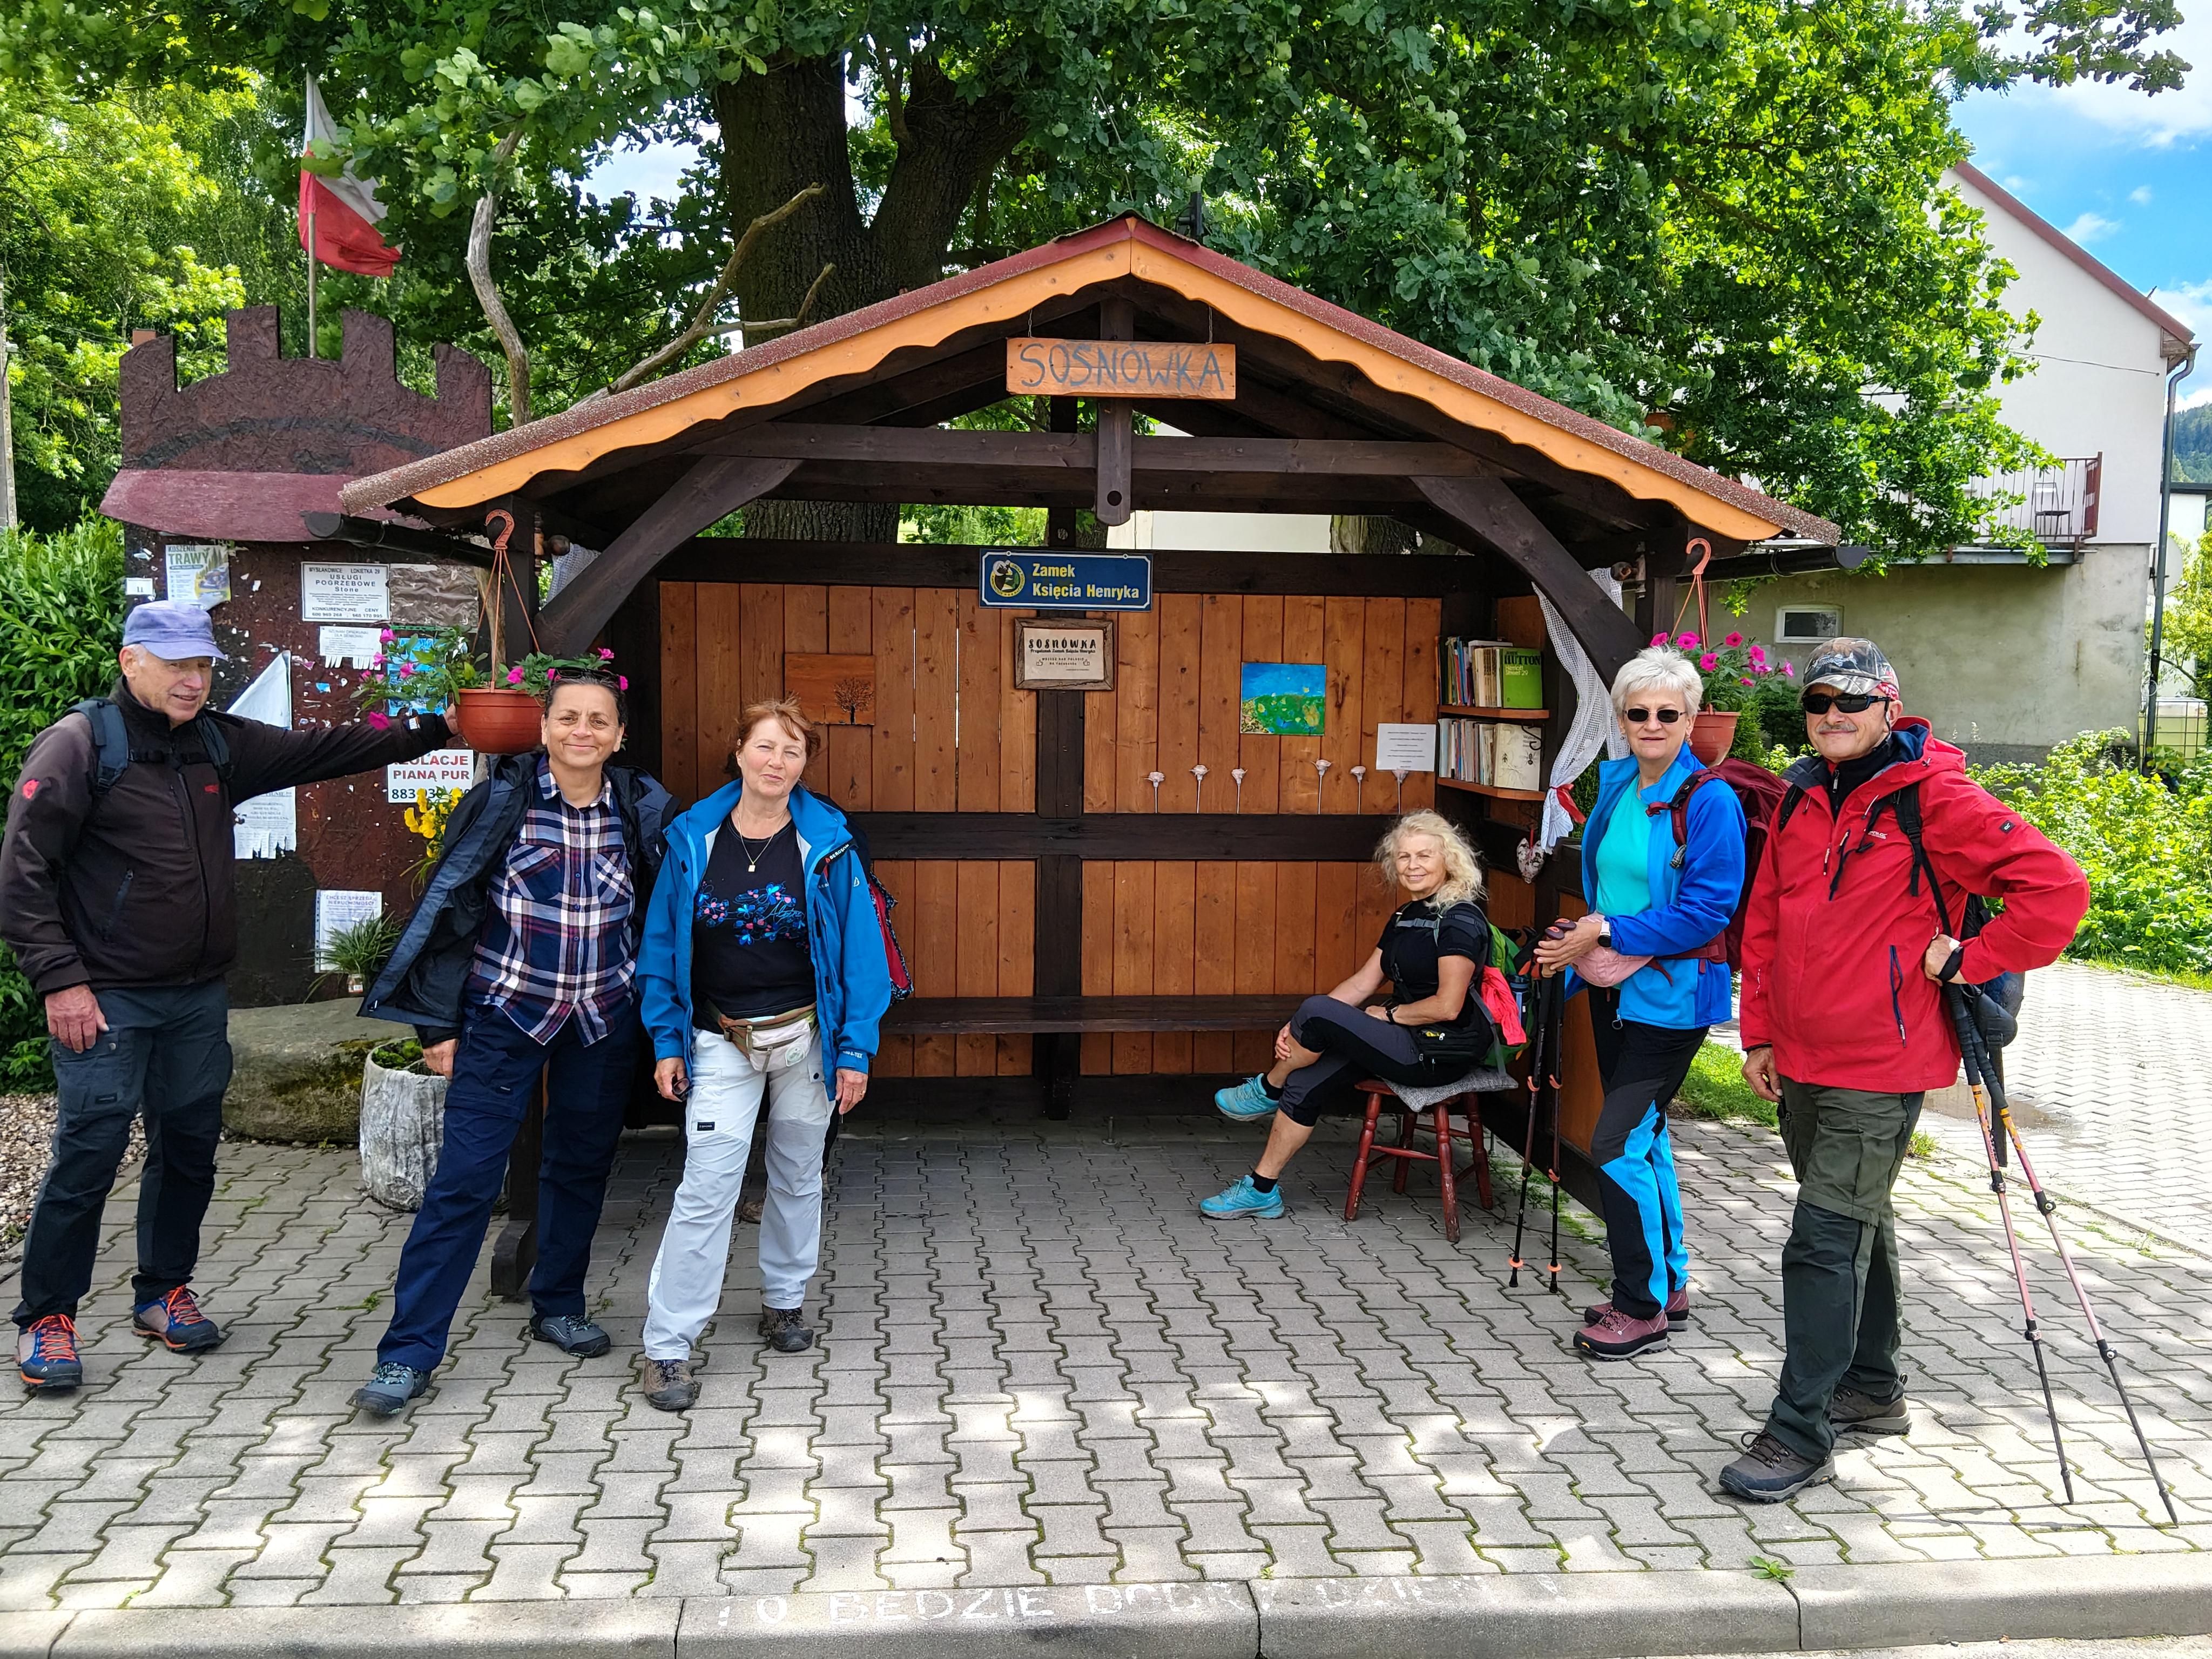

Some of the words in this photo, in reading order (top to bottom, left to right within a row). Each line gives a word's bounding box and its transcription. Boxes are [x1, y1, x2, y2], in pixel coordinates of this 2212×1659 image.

[1020, 342, 1225, 391] SOSNÓWKA
[168, 552, 209, 565] TRAWY
[1033, 563, 1076, 578] Zamek
[1033, 583, 1082, 599] Księcia
[1086, 584, 1139, 601] Henryka
[1028, 637, 1096, 649] SOSNÓWKA
[1505, 655, 1540, 665] HUTTON
[394, 756, 468, 766] OLACJE
[393, 770, 437, 782] PIANĄ
[441, 770, 470, 780] PUR
[392, 788, 416, 799] 883
